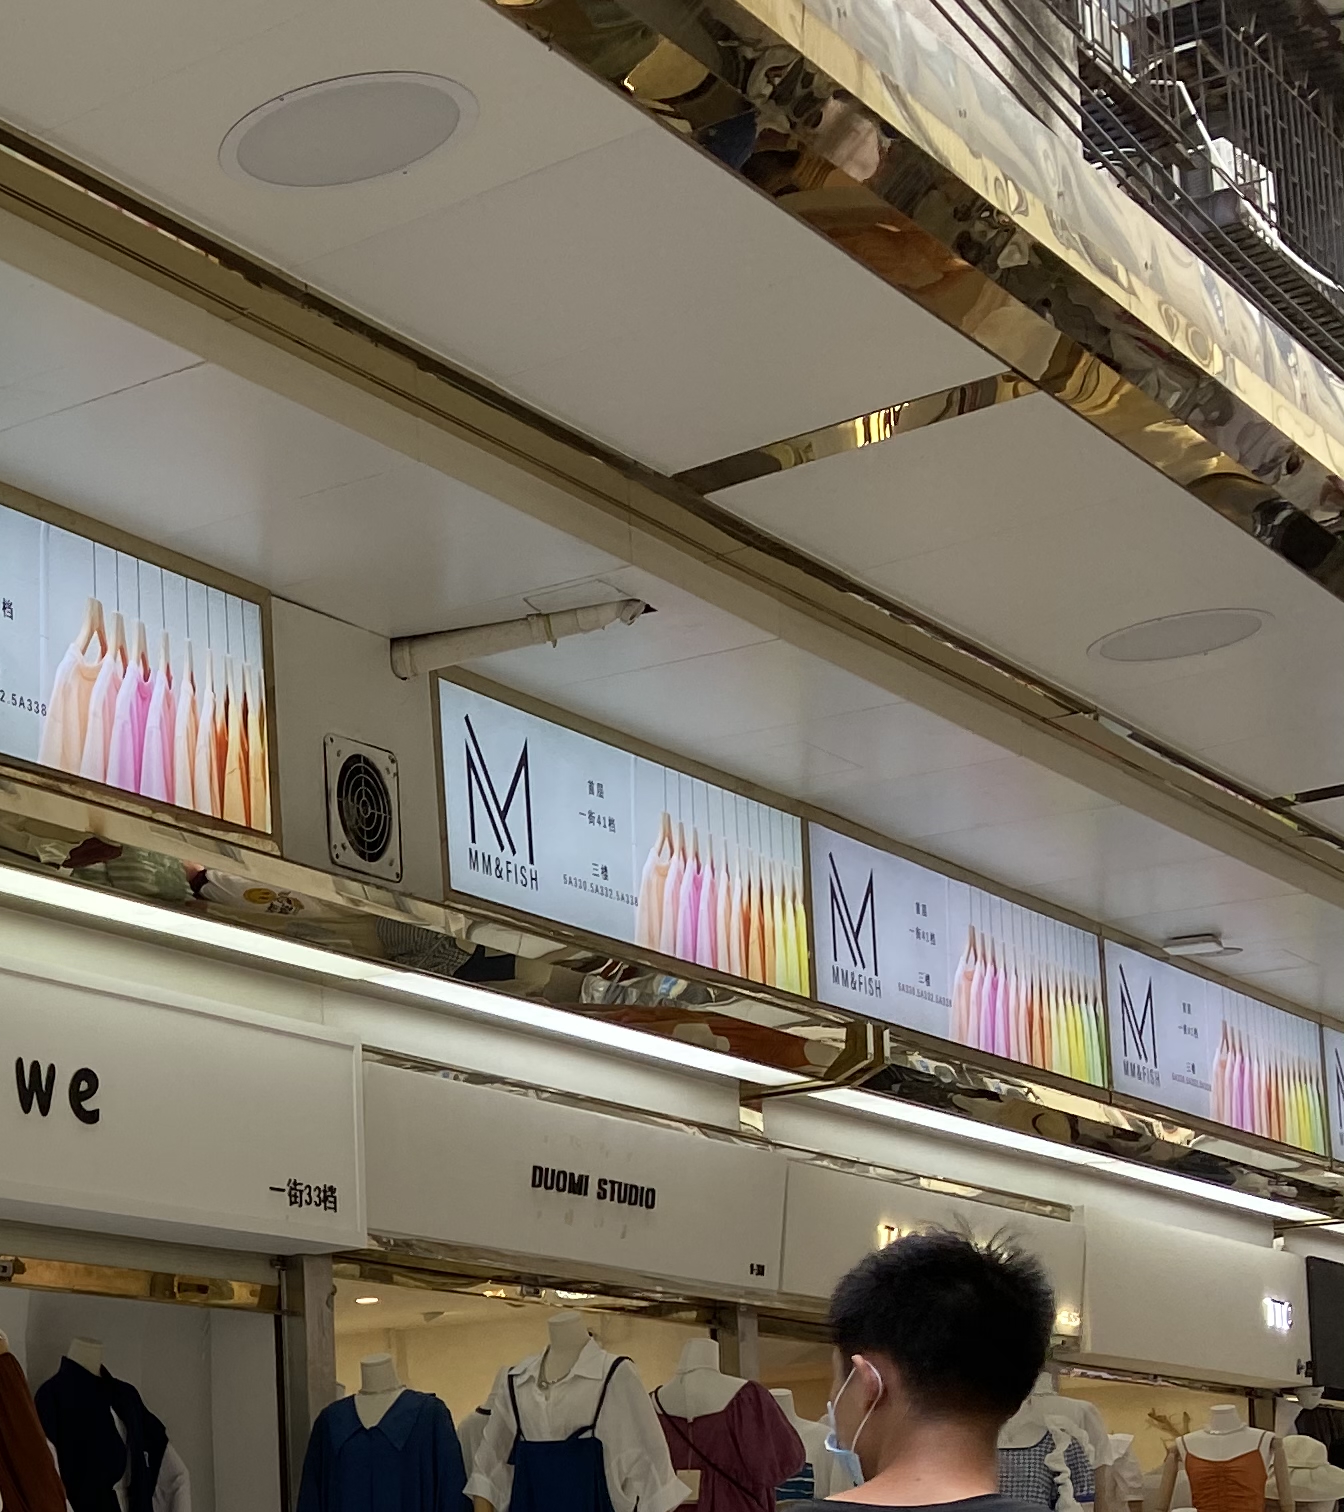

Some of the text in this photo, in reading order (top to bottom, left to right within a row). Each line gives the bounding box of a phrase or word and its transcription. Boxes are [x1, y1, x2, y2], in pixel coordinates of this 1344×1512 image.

[468, 847, 539, 891] MM&FISH
[831, 964, 882, 999] MM&FISH
[269, 1178, 338, 1213] 一街33档
[530, 1164, 656, 1210] DUOMI STUDIO
